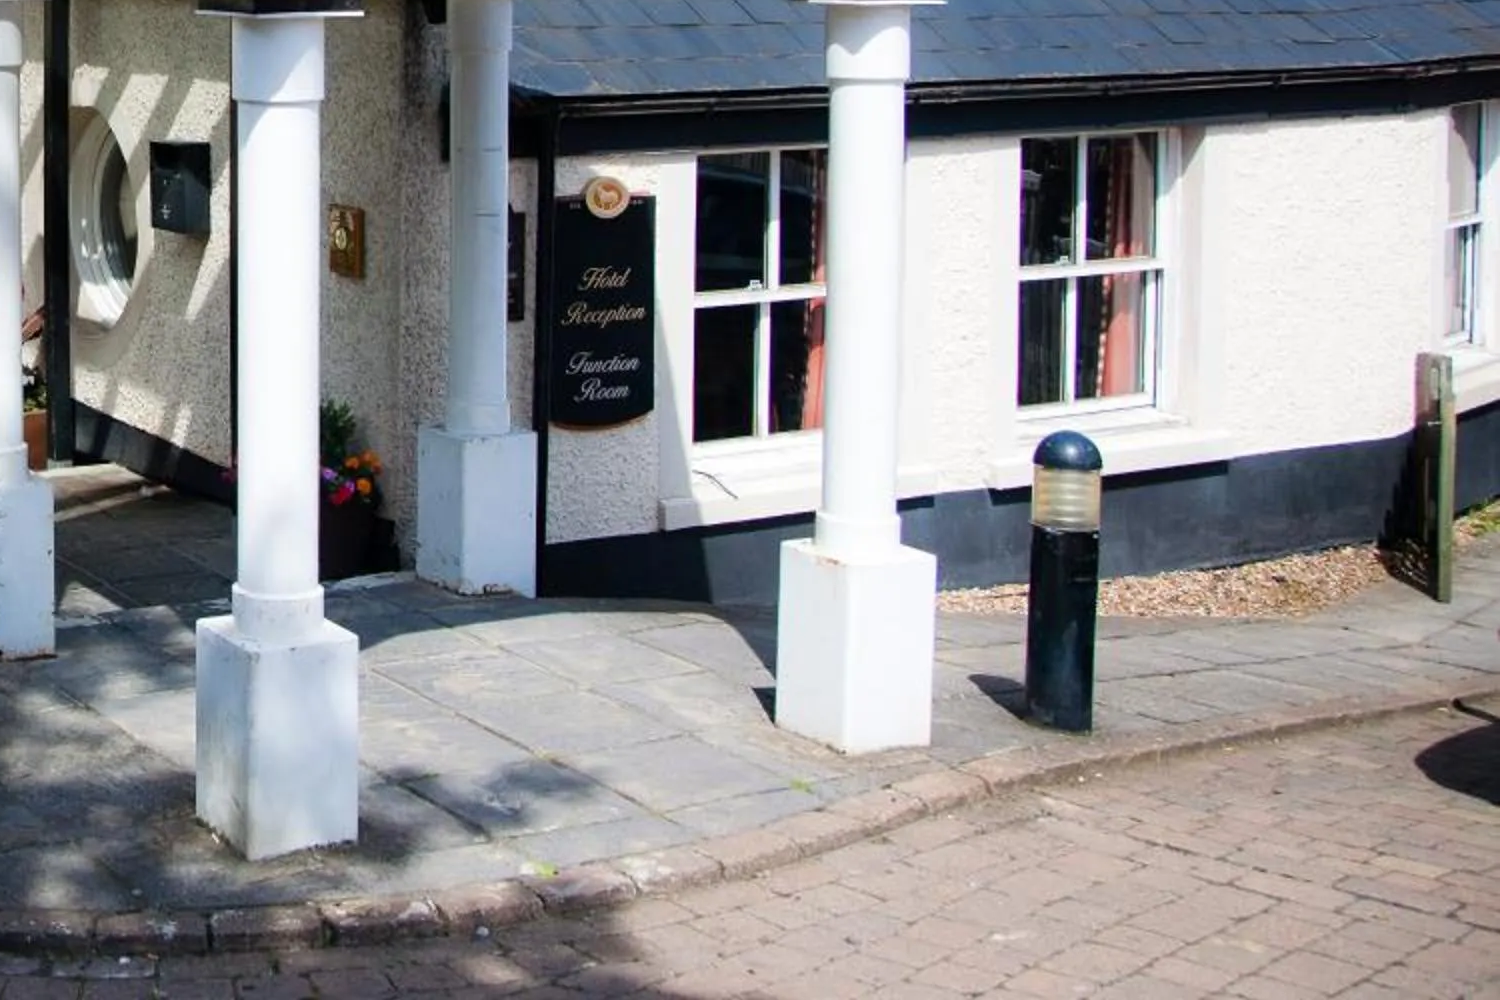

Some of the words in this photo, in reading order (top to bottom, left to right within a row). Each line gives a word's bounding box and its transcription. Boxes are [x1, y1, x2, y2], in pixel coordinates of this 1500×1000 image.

[577, 265, 632, 291] Hotel
[560, 300, 647, 328] Reception
[565, 350, 640, 375] Function
[573, 377, 630, 402] Room
